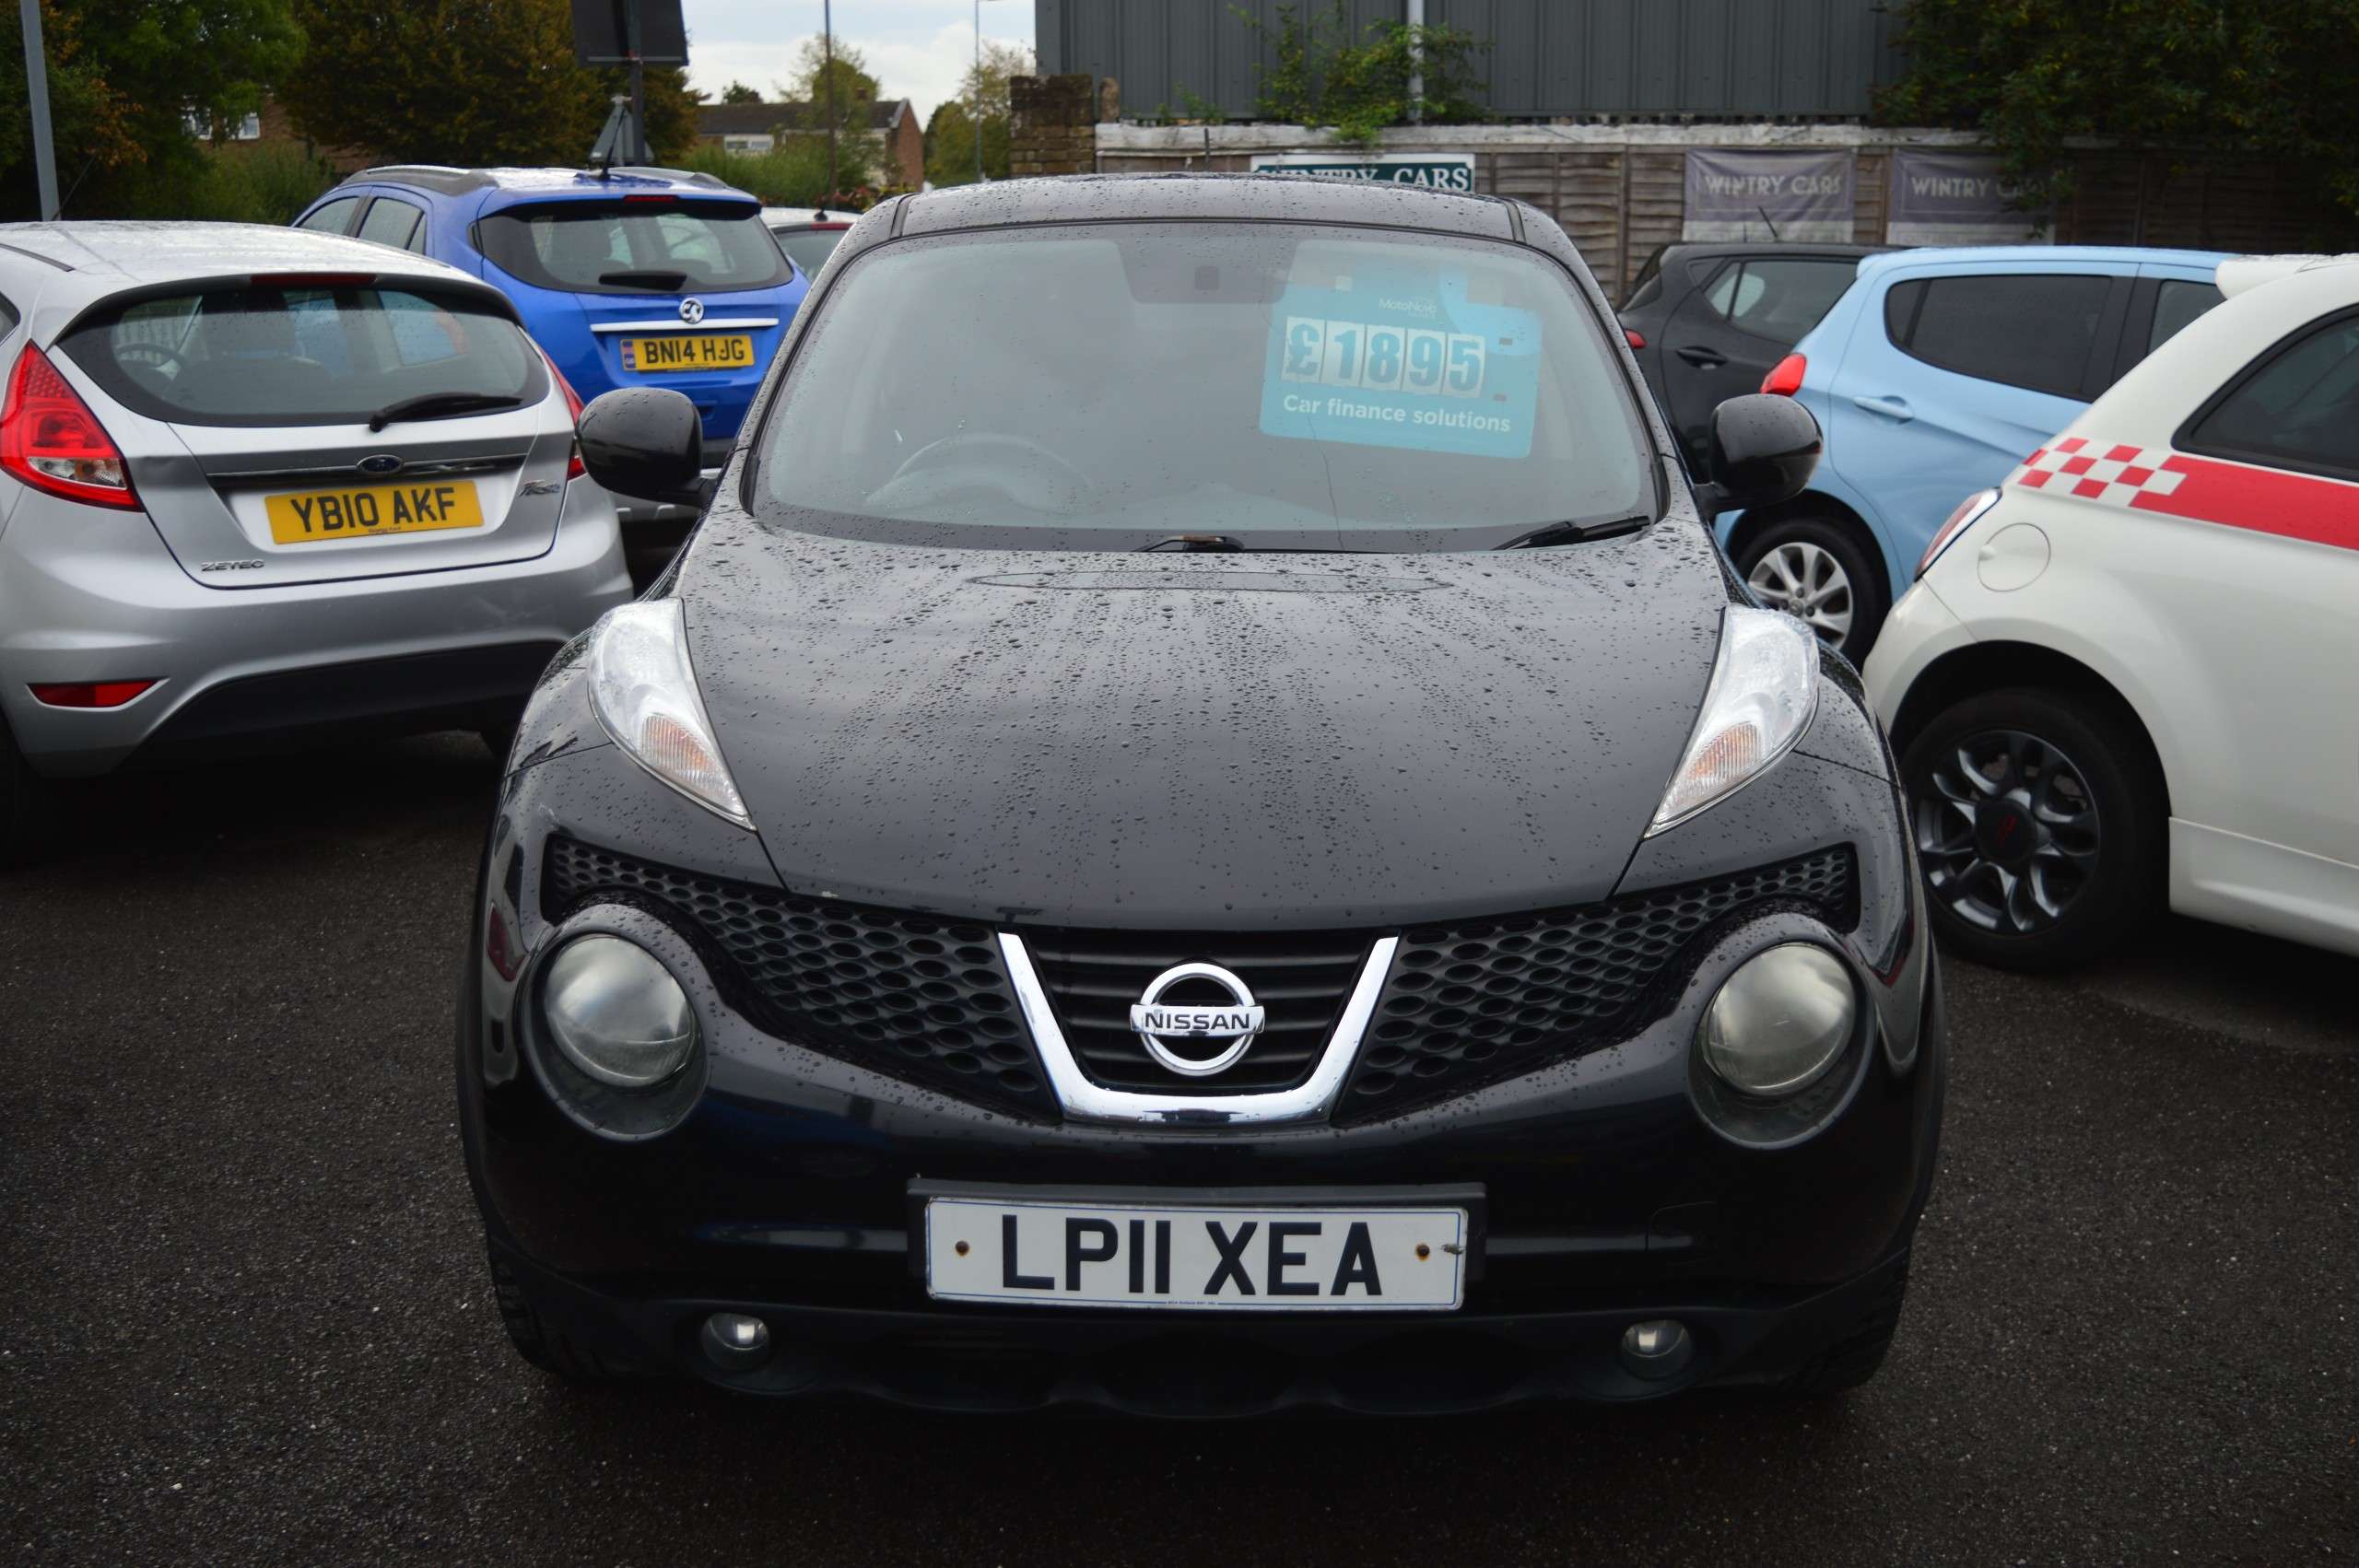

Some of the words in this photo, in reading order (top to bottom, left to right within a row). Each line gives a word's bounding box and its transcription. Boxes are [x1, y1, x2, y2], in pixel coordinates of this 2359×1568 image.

[1393, 168, 1470, 191] CARS
[1790, 175, 1842, 194] CARS
[1911, 177, 1990, 197] WINTRY
[644, 340, 696, 363] BN14
[702, 339, 745, 360] HJG
[1285, 323, 1482, 392] £1895
[1284, 394, 1321, 414] Car
[1327, 398, 1406, 422] finance
[1412, 409, 1512, 432] solutions
[290, 492, 380, 532] YB10
[393, 487, 454, 524] AKF
[201, 558, 265, 571] ZETEC
[1144, 1012, 1250, 1030] NISSAN
[1002, 1214, 1171, 1294] LP11
[1203, 1221, 1383, 1296] XEA
